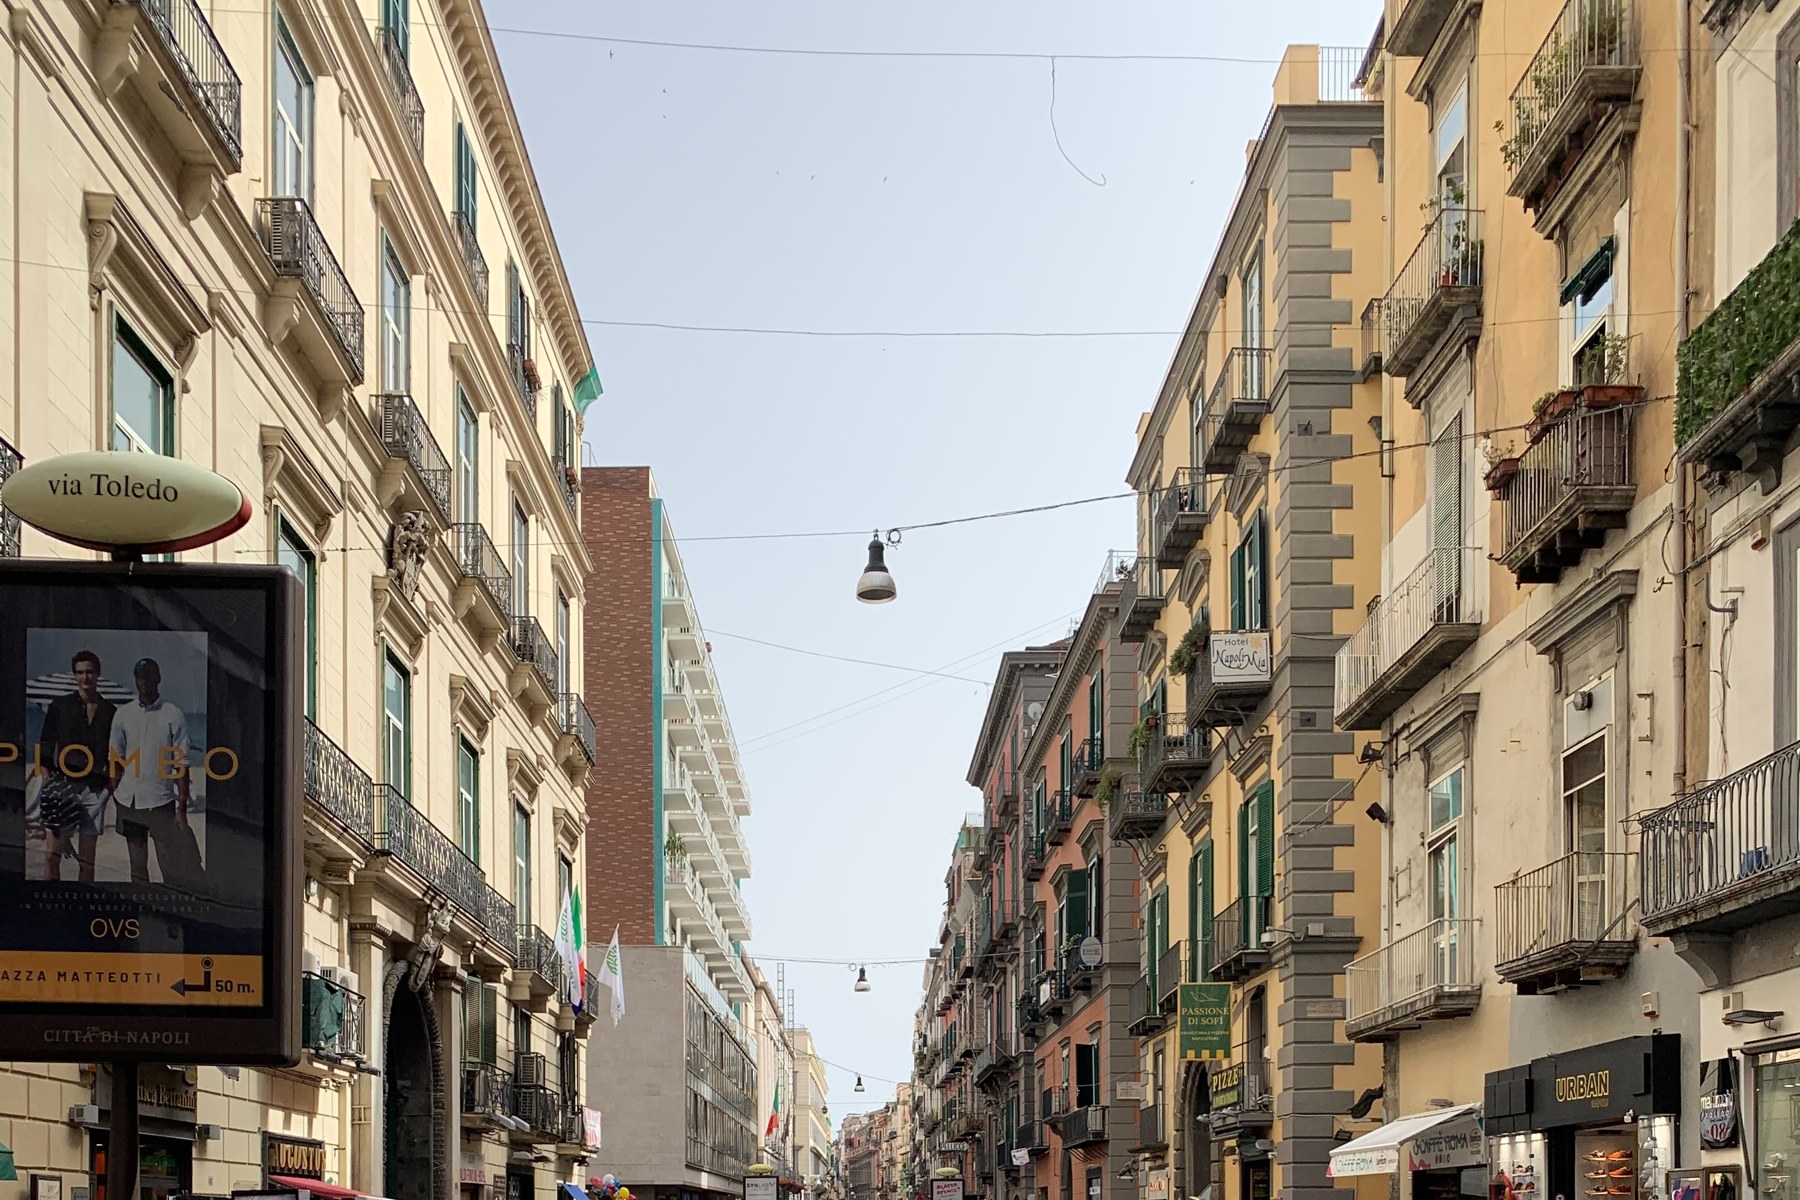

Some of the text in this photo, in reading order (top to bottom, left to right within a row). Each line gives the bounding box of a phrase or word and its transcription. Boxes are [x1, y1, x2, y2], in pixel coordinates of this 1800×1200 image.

[48, 473, 178, 503] via Toledo
[1224, 638, 1249, 646] Hotel
[1213, 648, 1267, 673] Napoli Mia
[90, 918, 140, 939] OVS
[57, 971, 161, 984] MATTEOTTI
[215, 980, 255, 994] 50 m.
[1182, 1007, 1229, 1015] PASSIONE
[1188, 1017, 1198, 1025] DI
[103, 1030, 120, 1043] DI
[128, 1031, 190, 1045] NAPOLI
[1212, 1068, 1239, 1092] PIZZE
[1555, 1070, 1609, 1102] URBAN
[273, 1143, 326, 1171] AUGUSTUS
